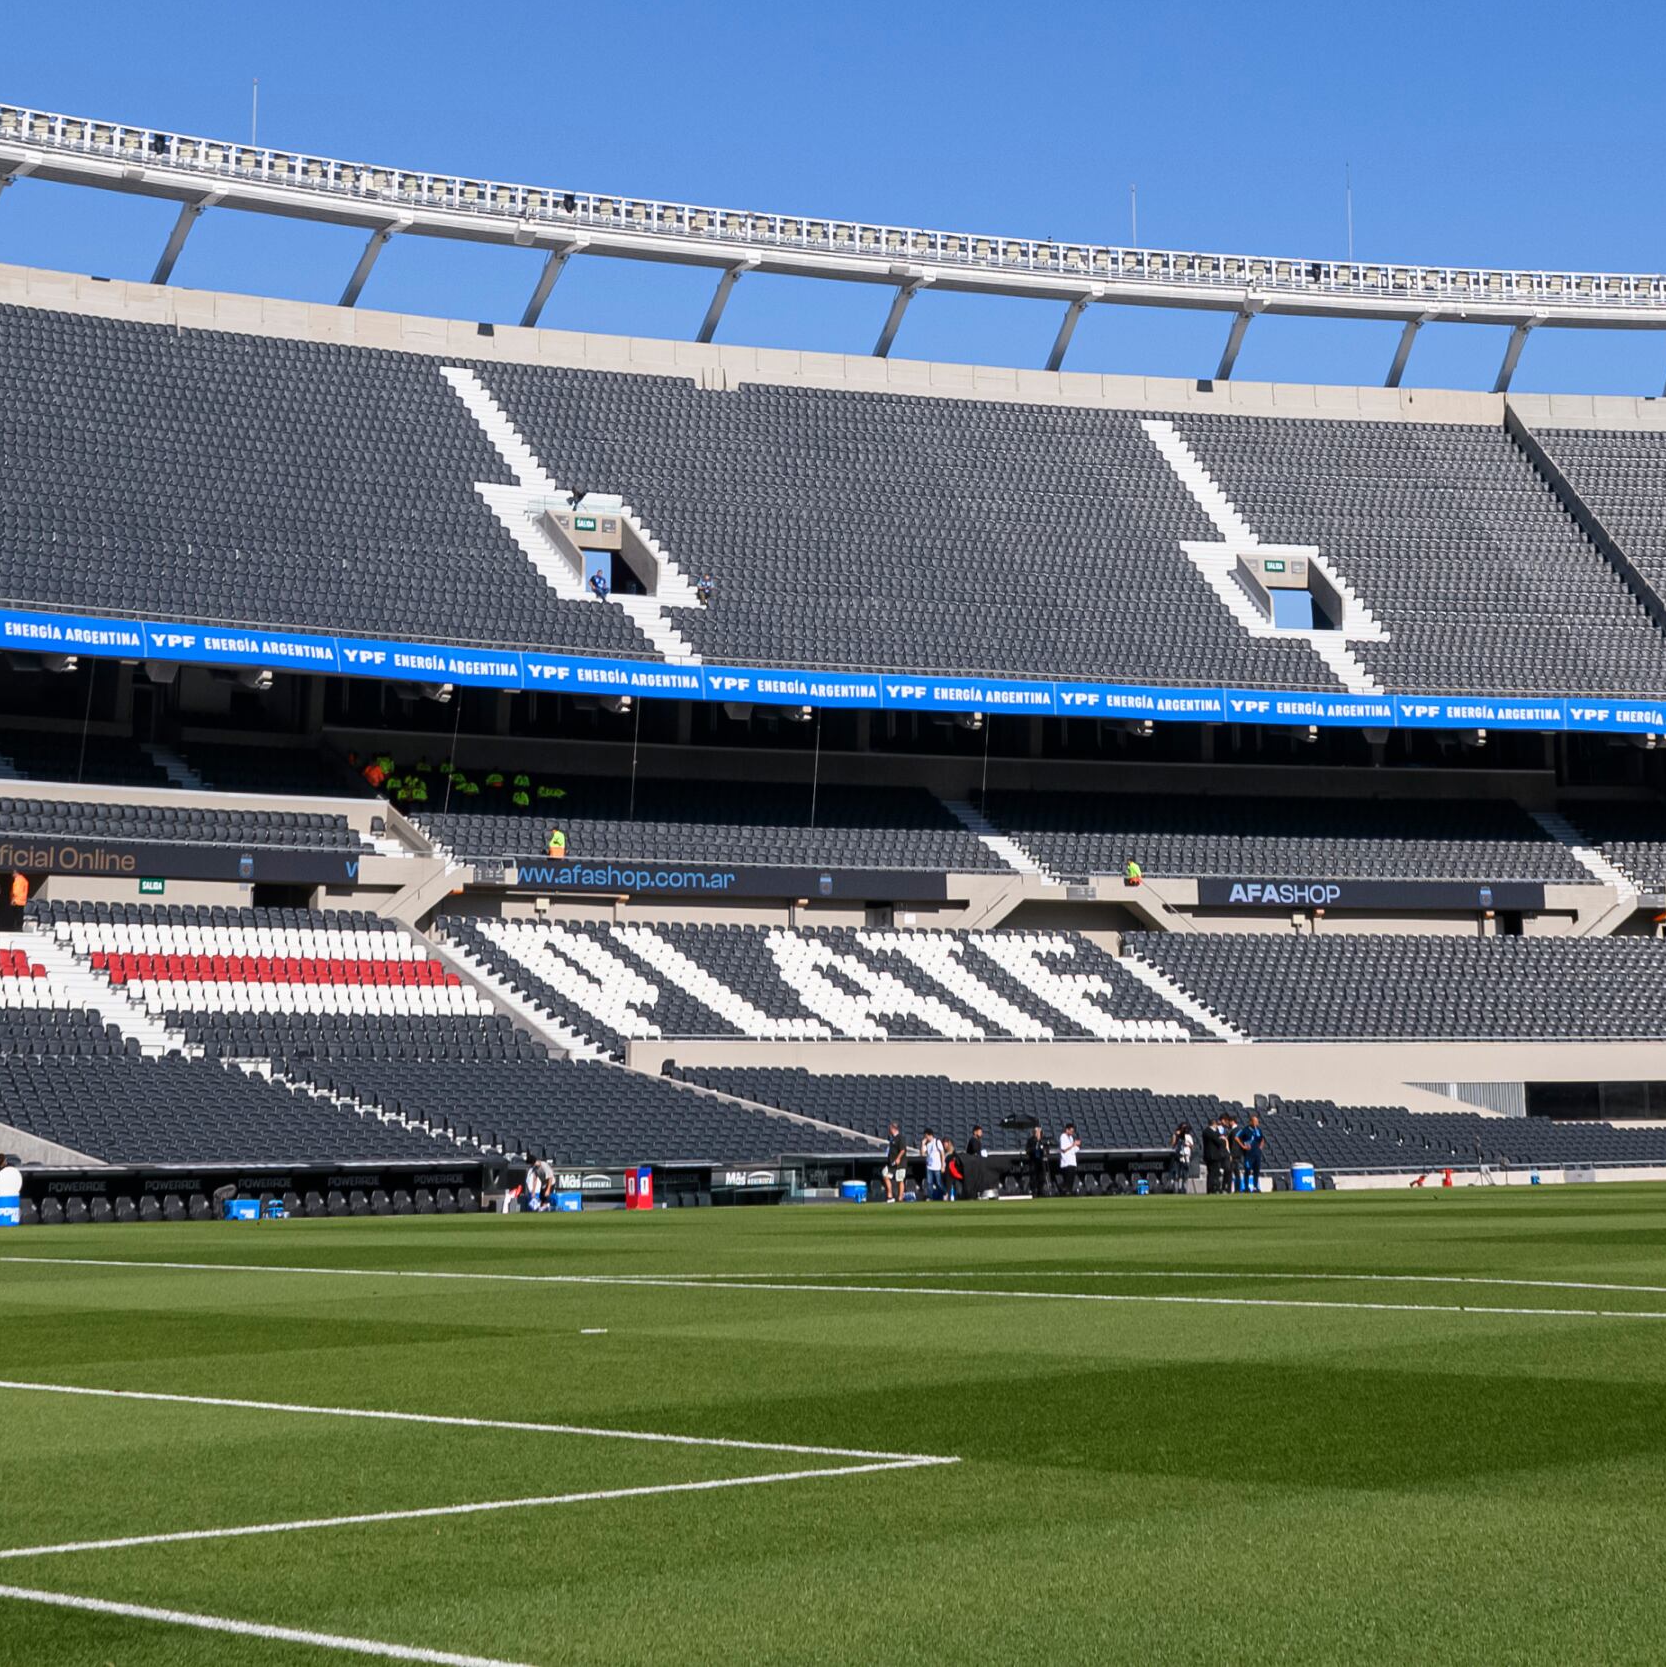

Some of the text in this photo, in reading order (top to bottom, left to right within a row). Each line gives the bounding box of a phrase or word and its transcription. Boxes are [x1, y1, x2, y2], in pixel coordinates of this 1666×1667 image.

[4, 621, 63, 640] ENERGÍA
[64, 627, 141, 646] ARGENTINA
[150, 633, 335, 660] YPF ENERGÍA ARGENTINA
[343, 648, 519, 677] YPF ENERGÍA ARGENTINA
[527, 664, 700, 689] YPF ENERGÍA ARGENTINA
[708, 676, 878, 698] YPF ENERGÍA ARGENTINA
[886, 684, 1052, 705] YPF ENERGÍA ARGENTINA
[1060, 692, 1222, 712] YPF ENERGÍA ARGENTINA
[1229, 699, 1393, 717] YPF ENERGÍA ARGENTINA
[1400, 704, 1562, 720] YPF ENERGÍA ARGENTINA
[1569, 708, 1611, 722] YPF
[1615, 710, 1665, 726] ENERGÍA
[58, 846, 136, 871] Online
[141, 881, 163, 891] SALIDA
[1229, 883, 1342, 905] AFASHOP
[476, 921, 1192, 1040] PLATE
[48, 1181, 107, 1193] POWERADE
[145, 1179, 201, 1191] POWERADE
